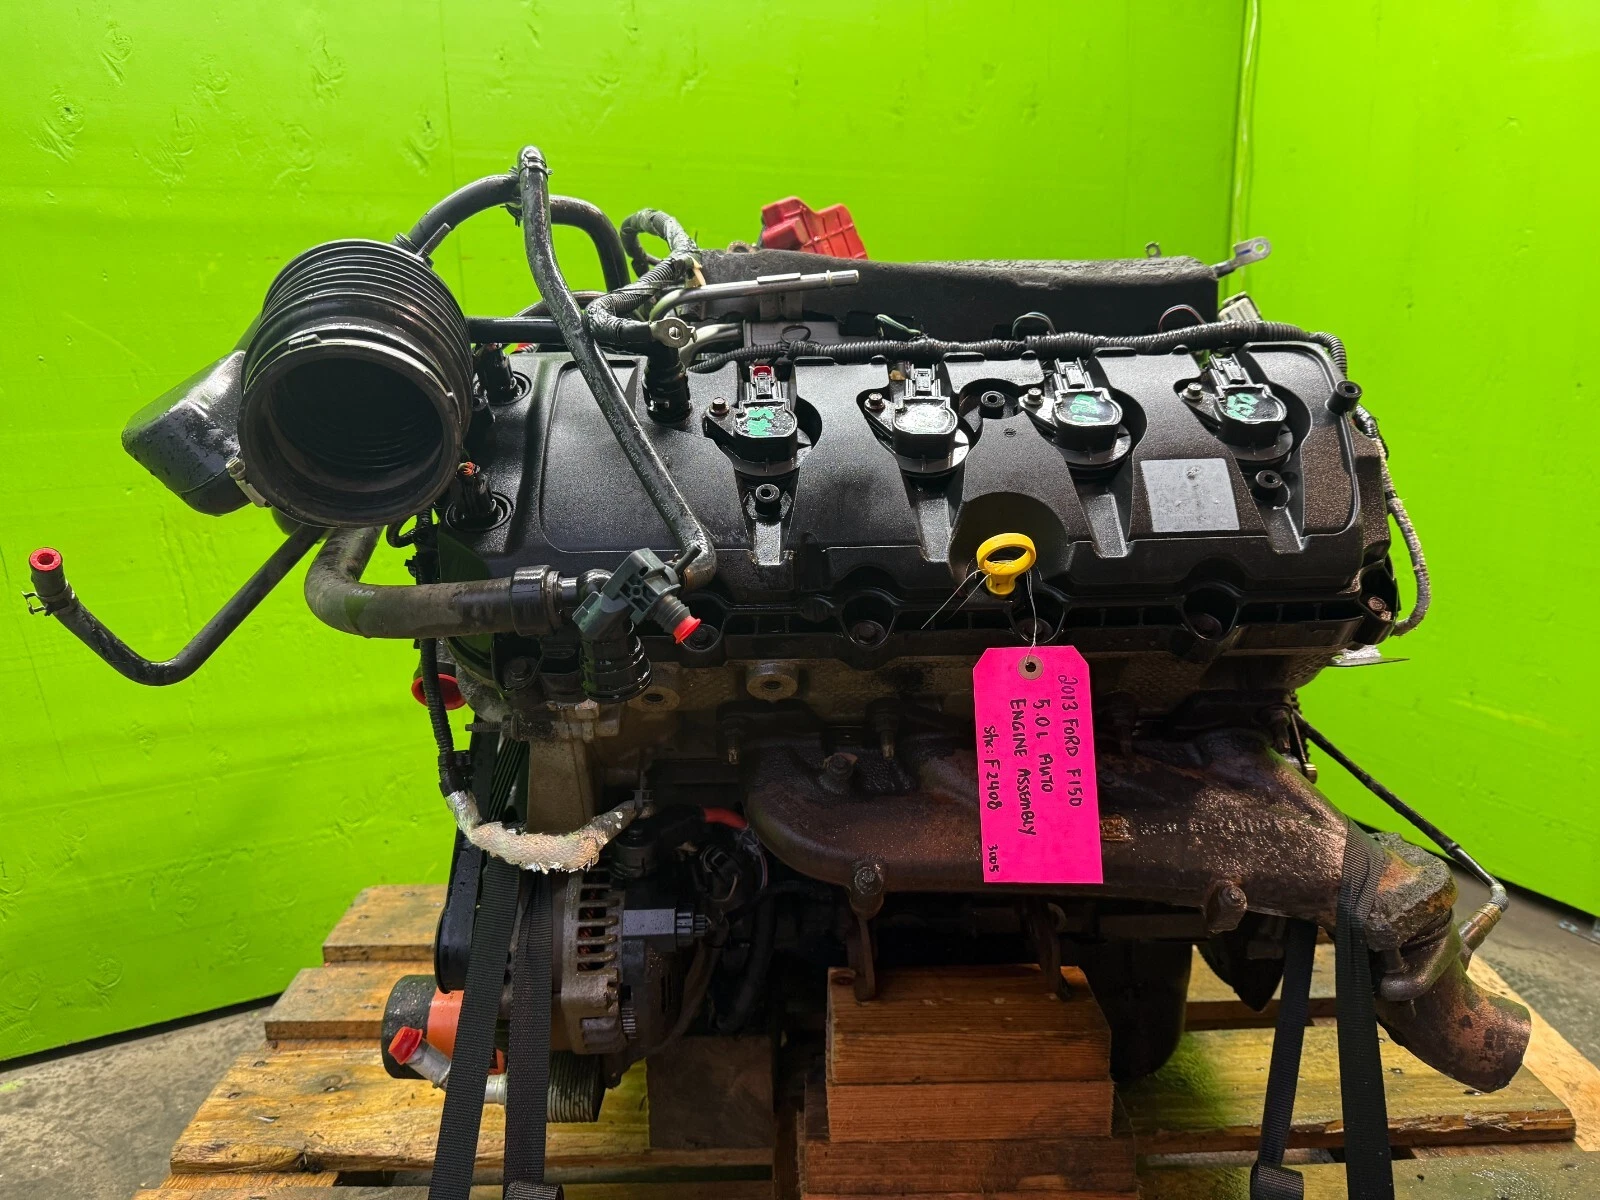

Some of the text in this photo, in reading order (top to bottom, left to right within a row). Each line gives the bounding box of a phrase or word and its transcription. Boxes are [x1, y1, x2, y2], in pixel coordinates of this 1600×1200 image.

[1057, 674, 1079, 711] 2013
[983, 759, 1003, 810] F2408
[1010, 698, 1036, 836] ENGINE ASSEMBLY
[1038, 753, 1054, 793] AUTO
[1066, 768, 1083, 807] F150
[987, 844, 1000, 873] 3005
